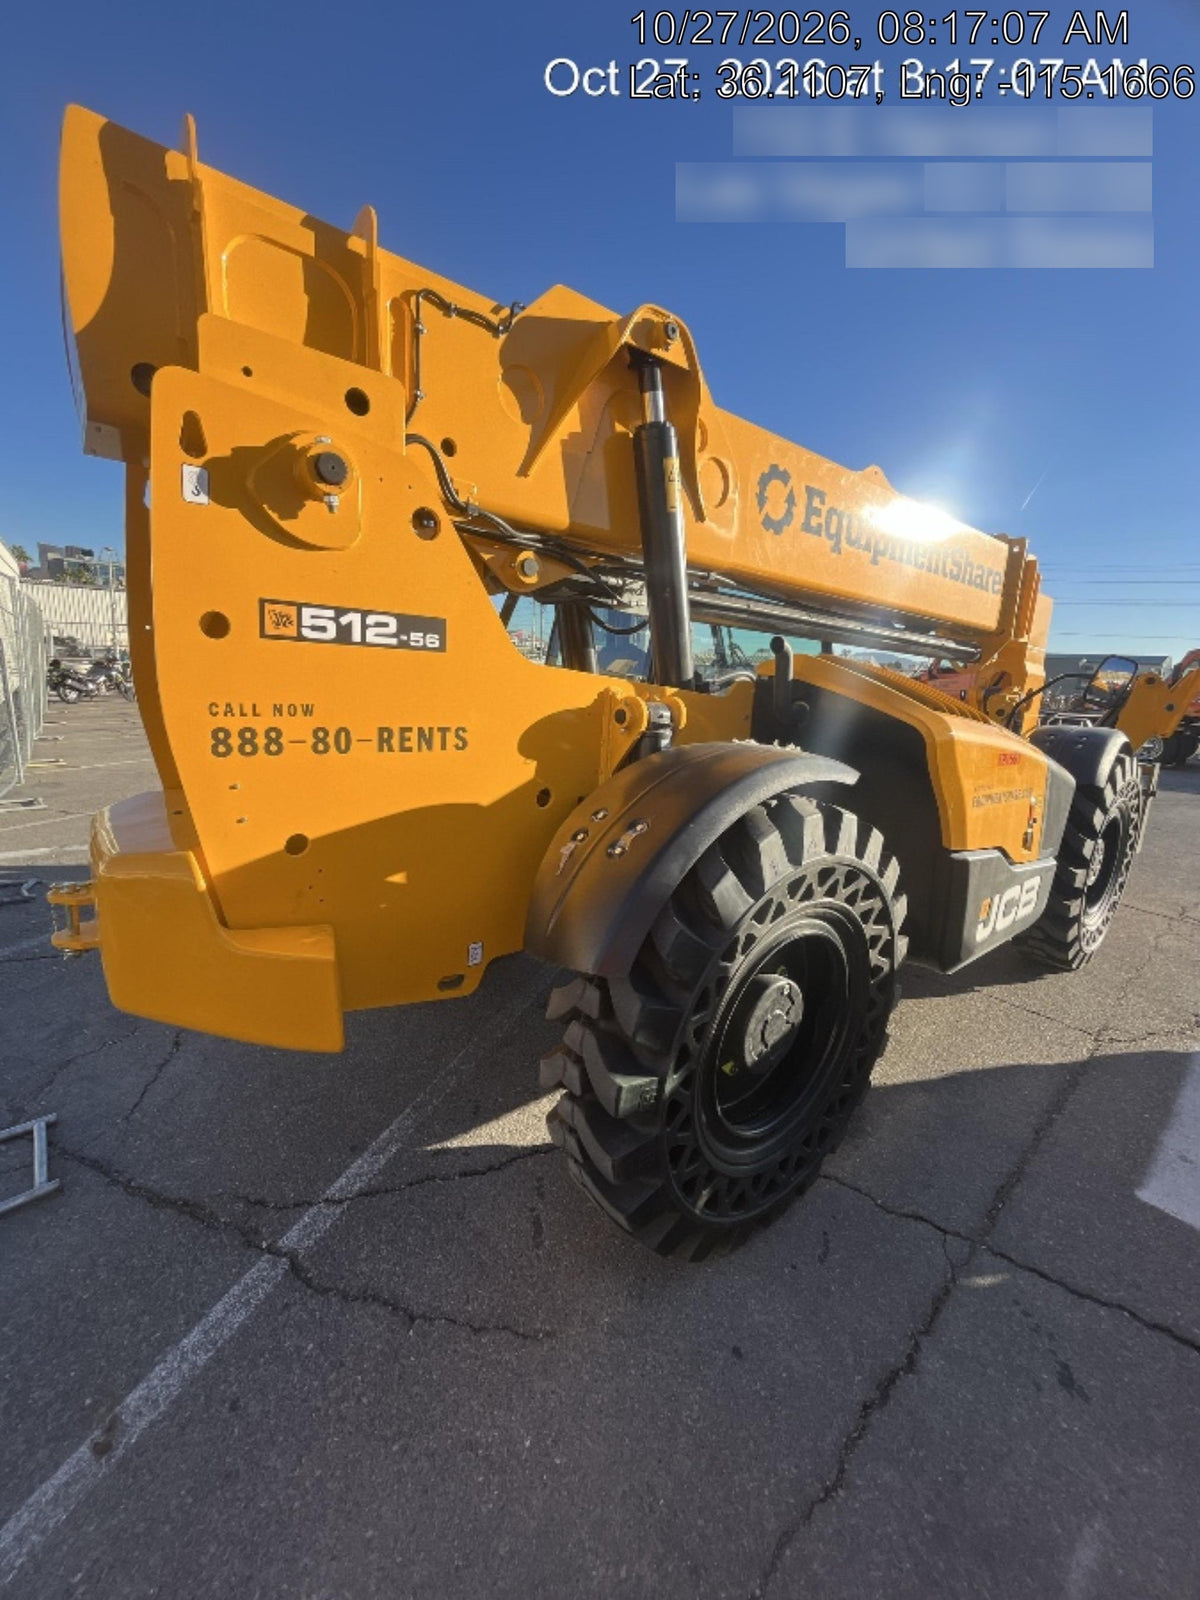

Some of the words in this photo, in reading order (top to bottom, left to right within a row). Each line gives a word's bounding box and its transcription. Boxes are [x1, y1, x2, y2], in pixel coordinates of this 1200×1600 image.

[208, 702, 261, 717] CALL
[272, 703, 315, 717] NOW
[976, 875, 1041, 943] JCB
